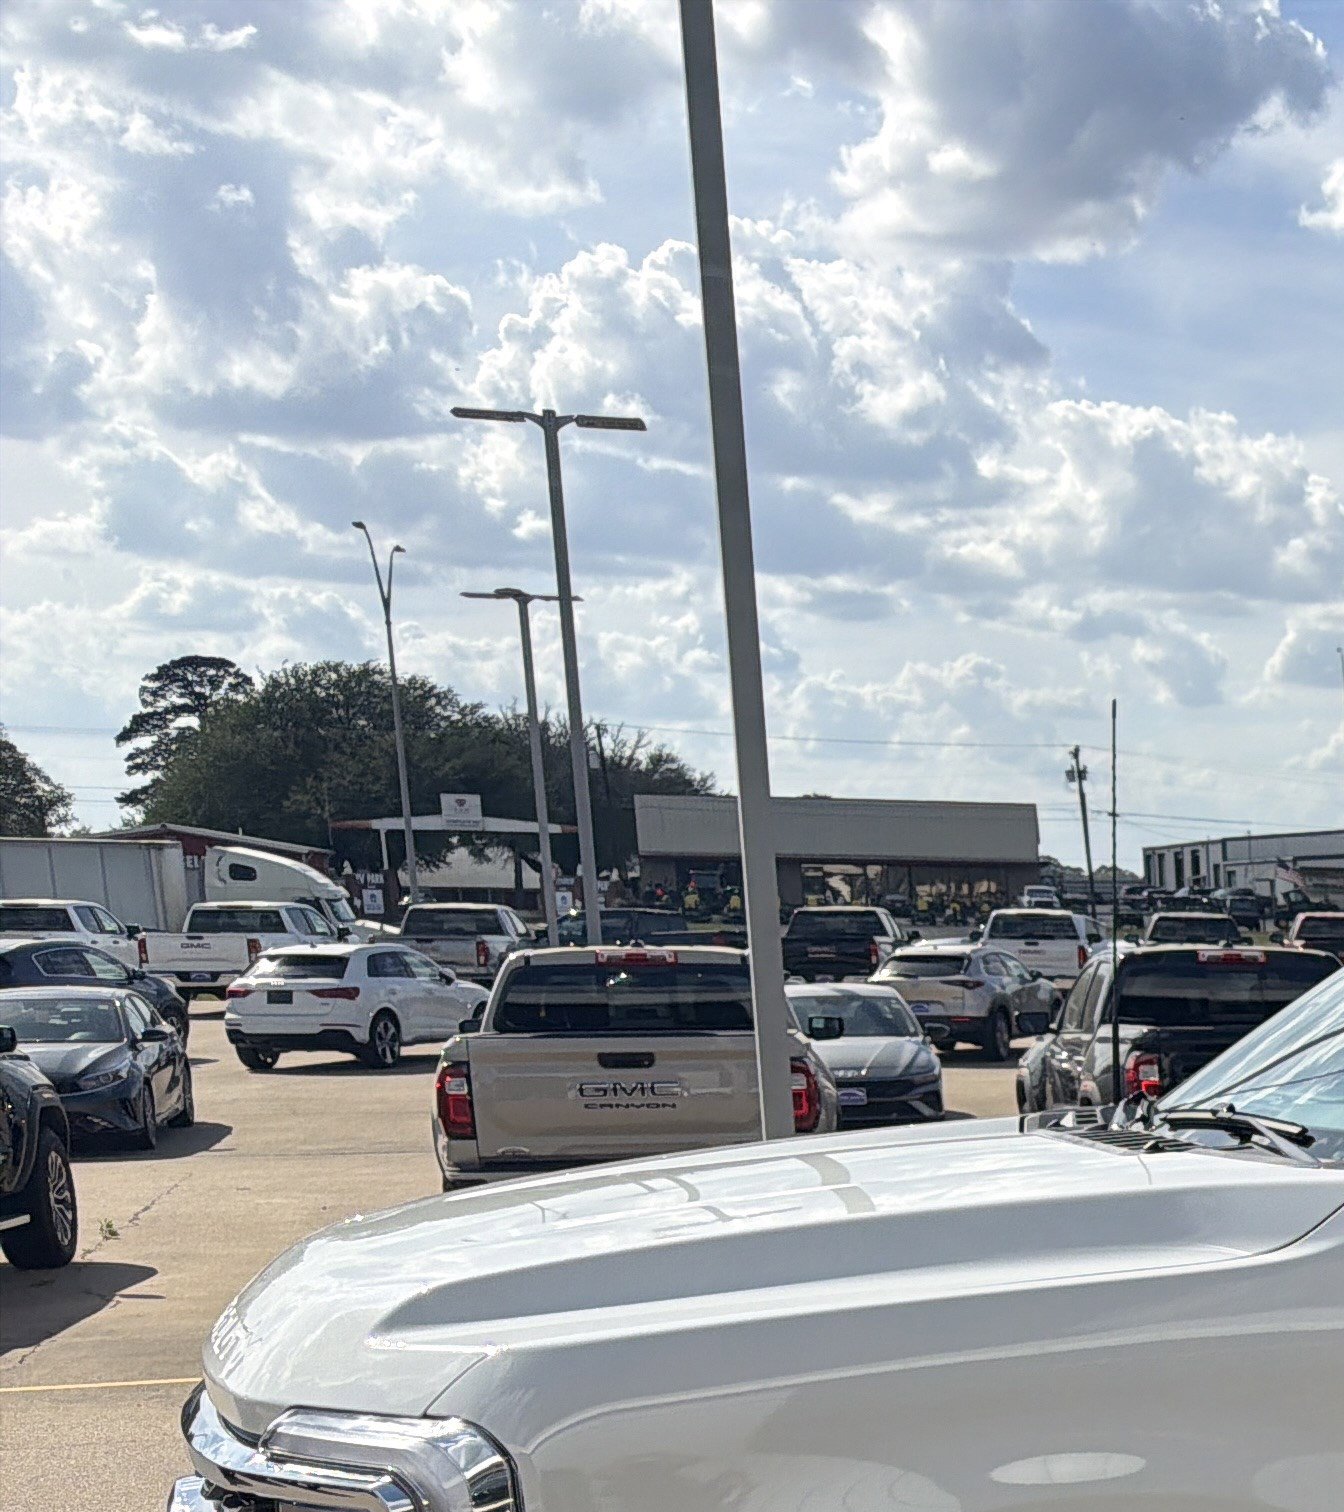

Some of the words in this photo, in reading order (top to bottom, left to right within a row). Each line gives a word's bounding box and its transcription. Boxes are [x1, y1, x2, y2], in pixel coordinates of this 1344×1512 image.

[180, 942, 211, 950] GMC
[576, 1080, 682, 1098] GMC
[583, 1102, 678, 1110] CANYON
